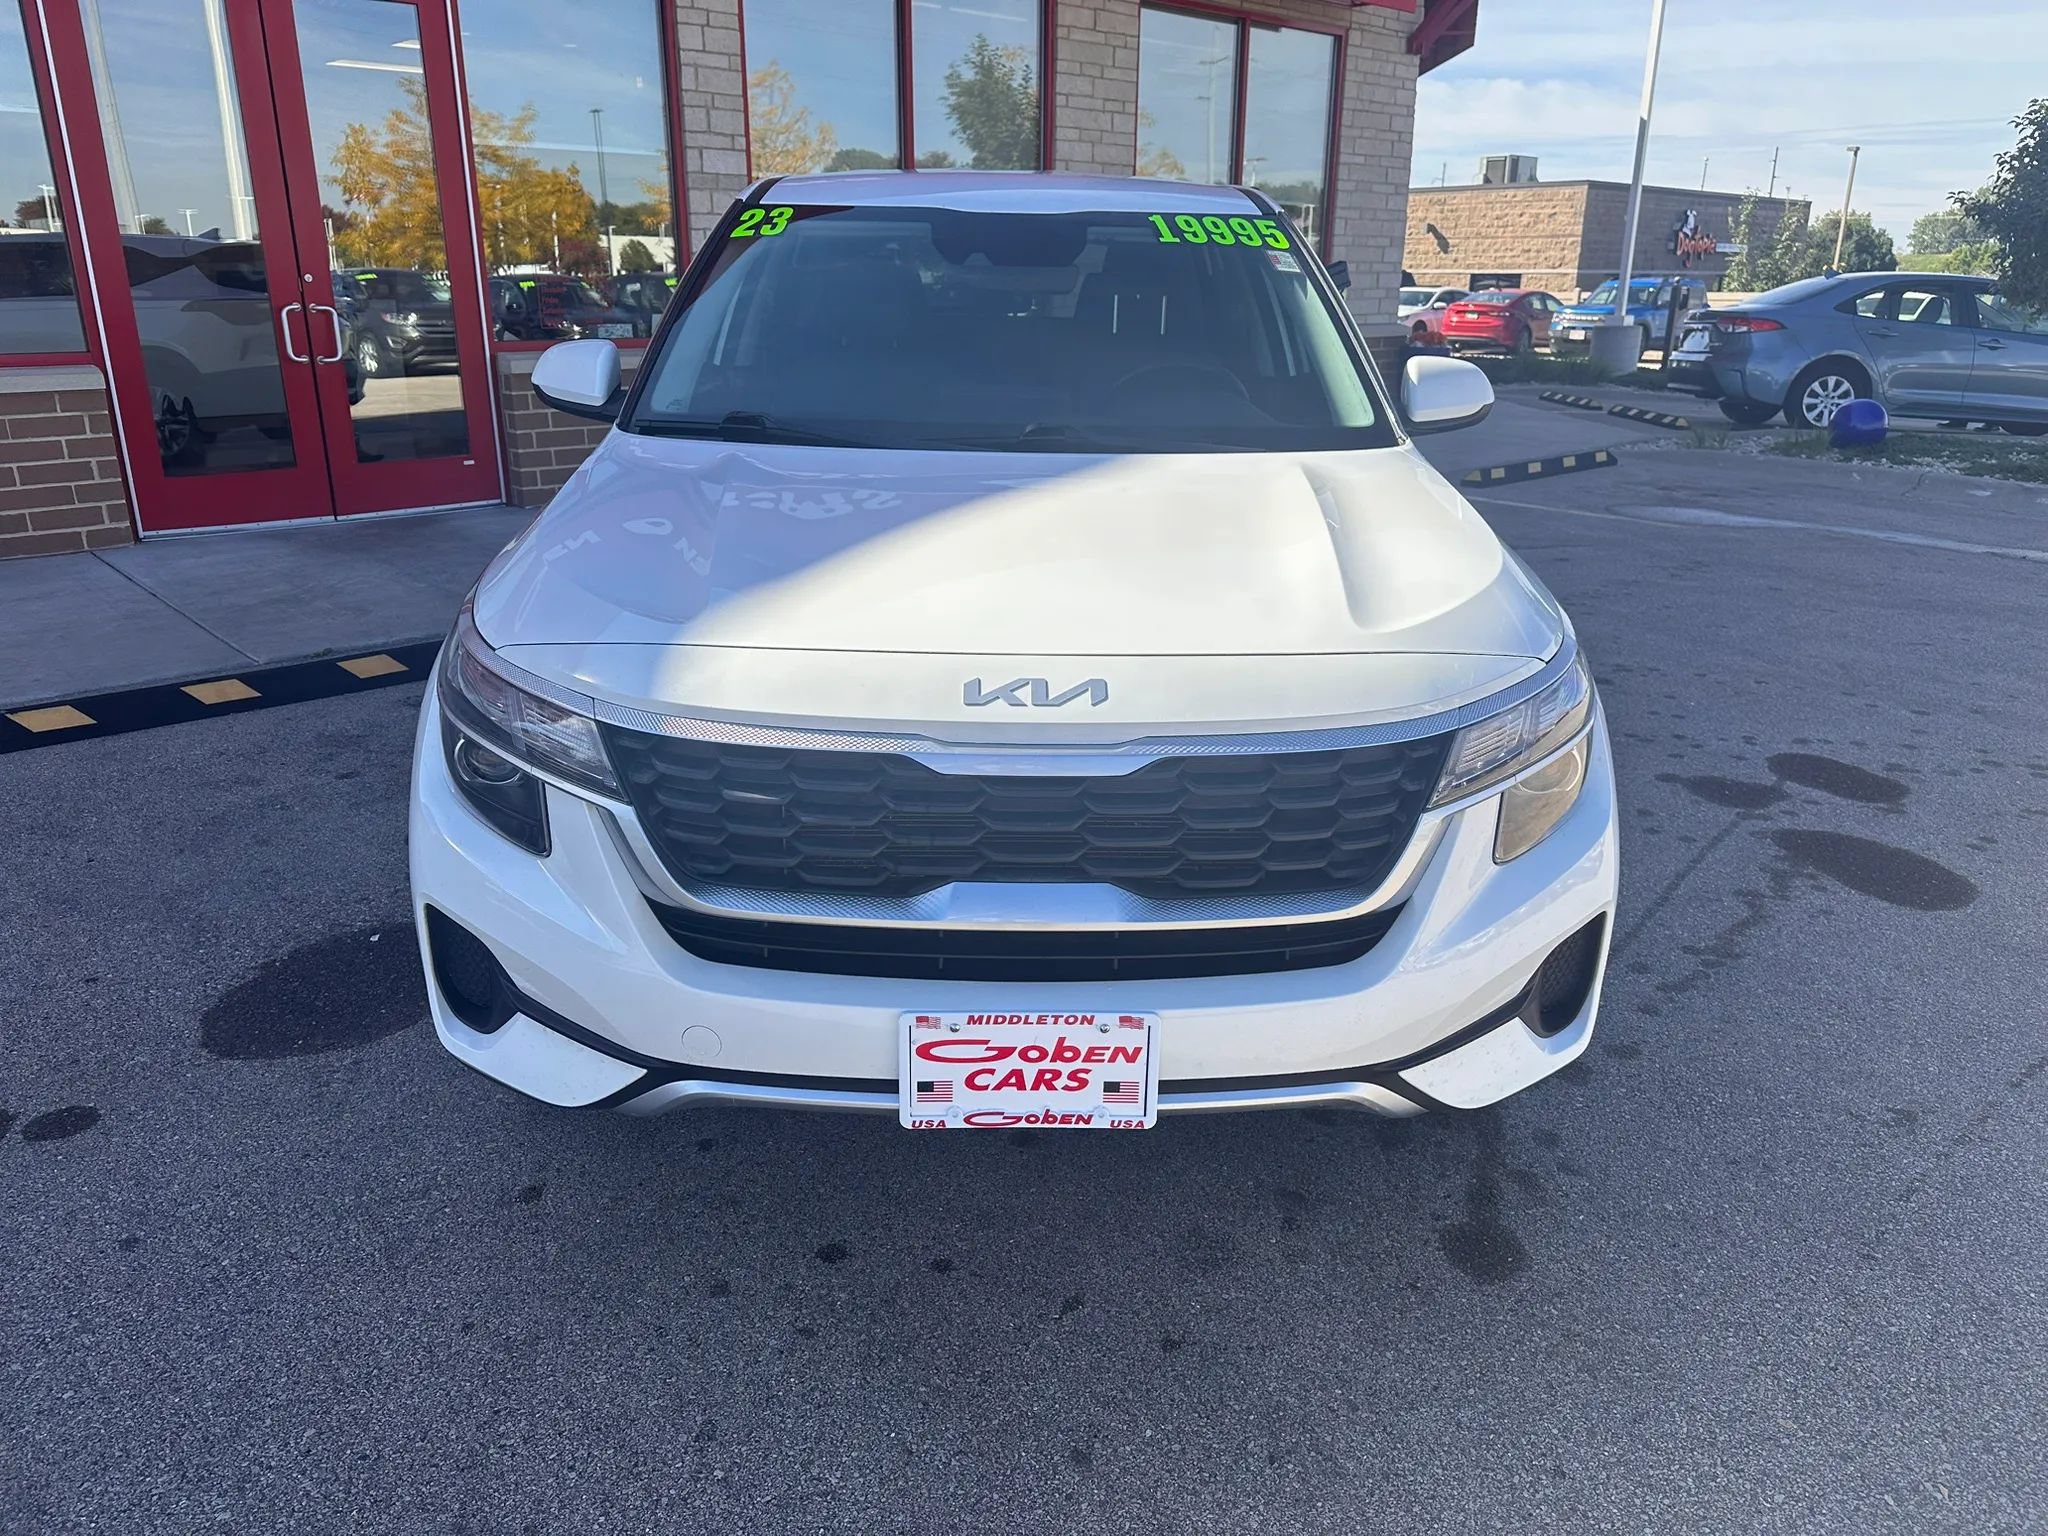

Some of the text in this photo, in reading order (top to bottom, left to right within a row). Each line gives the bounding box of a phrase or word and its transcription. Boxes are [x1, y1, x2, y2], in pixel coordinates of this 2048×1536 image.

[730, 206, 794, 238] 23
[1147, 214, 1290, 250] 19995
[963, 677, 1109, 707] KIA
[966, 1014, 1095, 1026] MIDDLETON
[964, 1068, 1093, 1092] CARS
[911, 1119, 947, 1129] USA
[1109, 1120, 1145, 1129] USA
